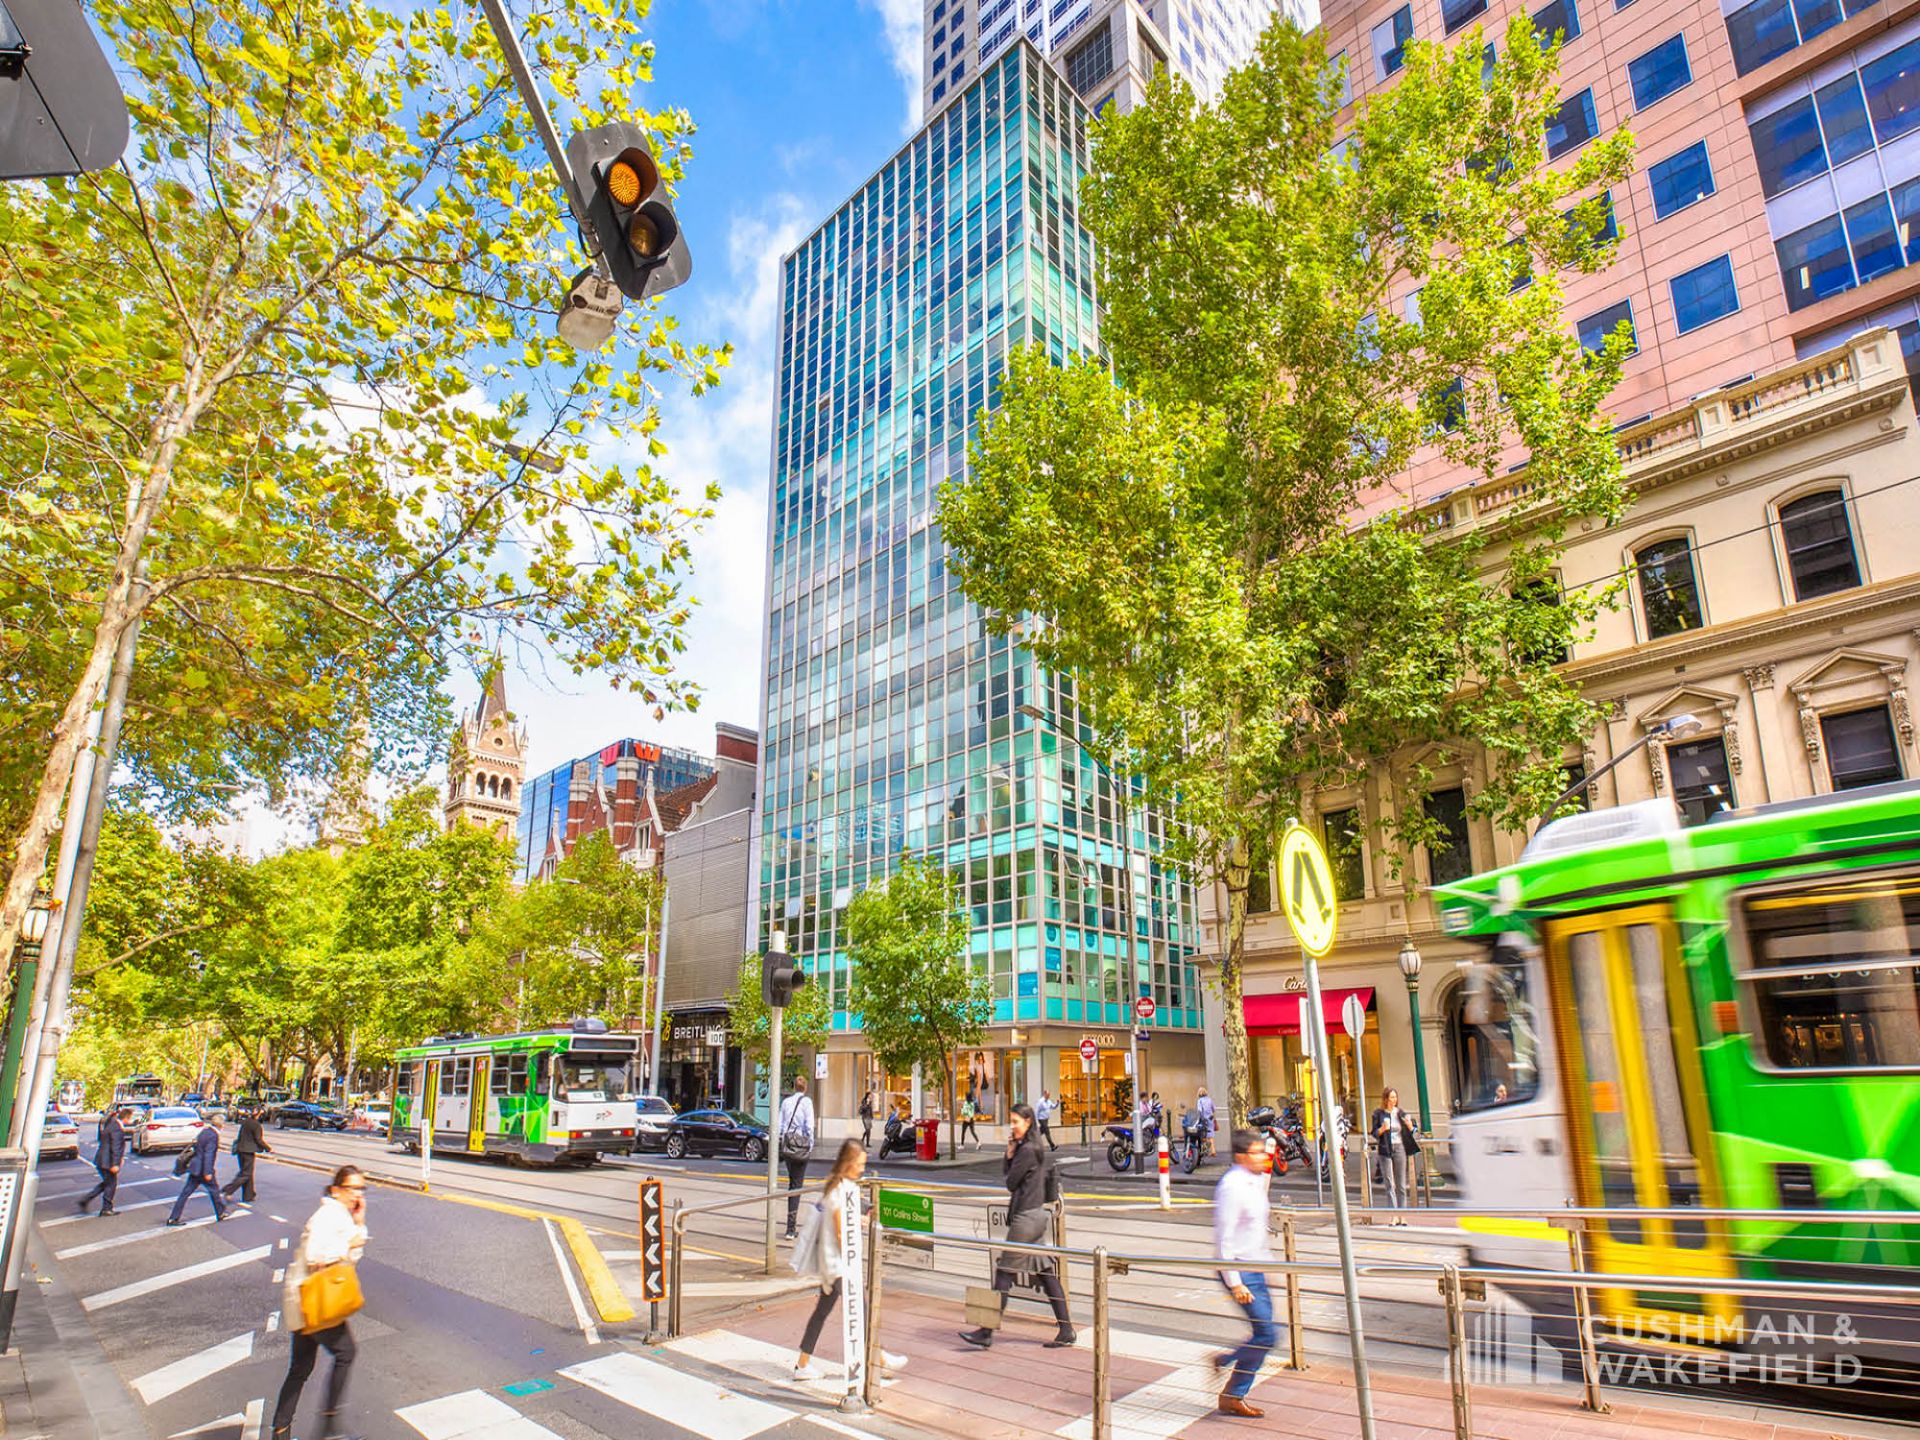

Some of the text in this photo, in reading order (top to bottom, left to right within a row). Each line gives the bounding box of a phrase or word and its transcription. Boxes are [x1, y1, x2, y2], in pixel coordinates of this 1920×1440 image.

[893, 1208, 911, 1220] Collins
[912, 1211, 930, 1223] Street
[991, 1211, 1010, 1226] GIV
[846, 1191, 858, 1356] KEEP LEFT
